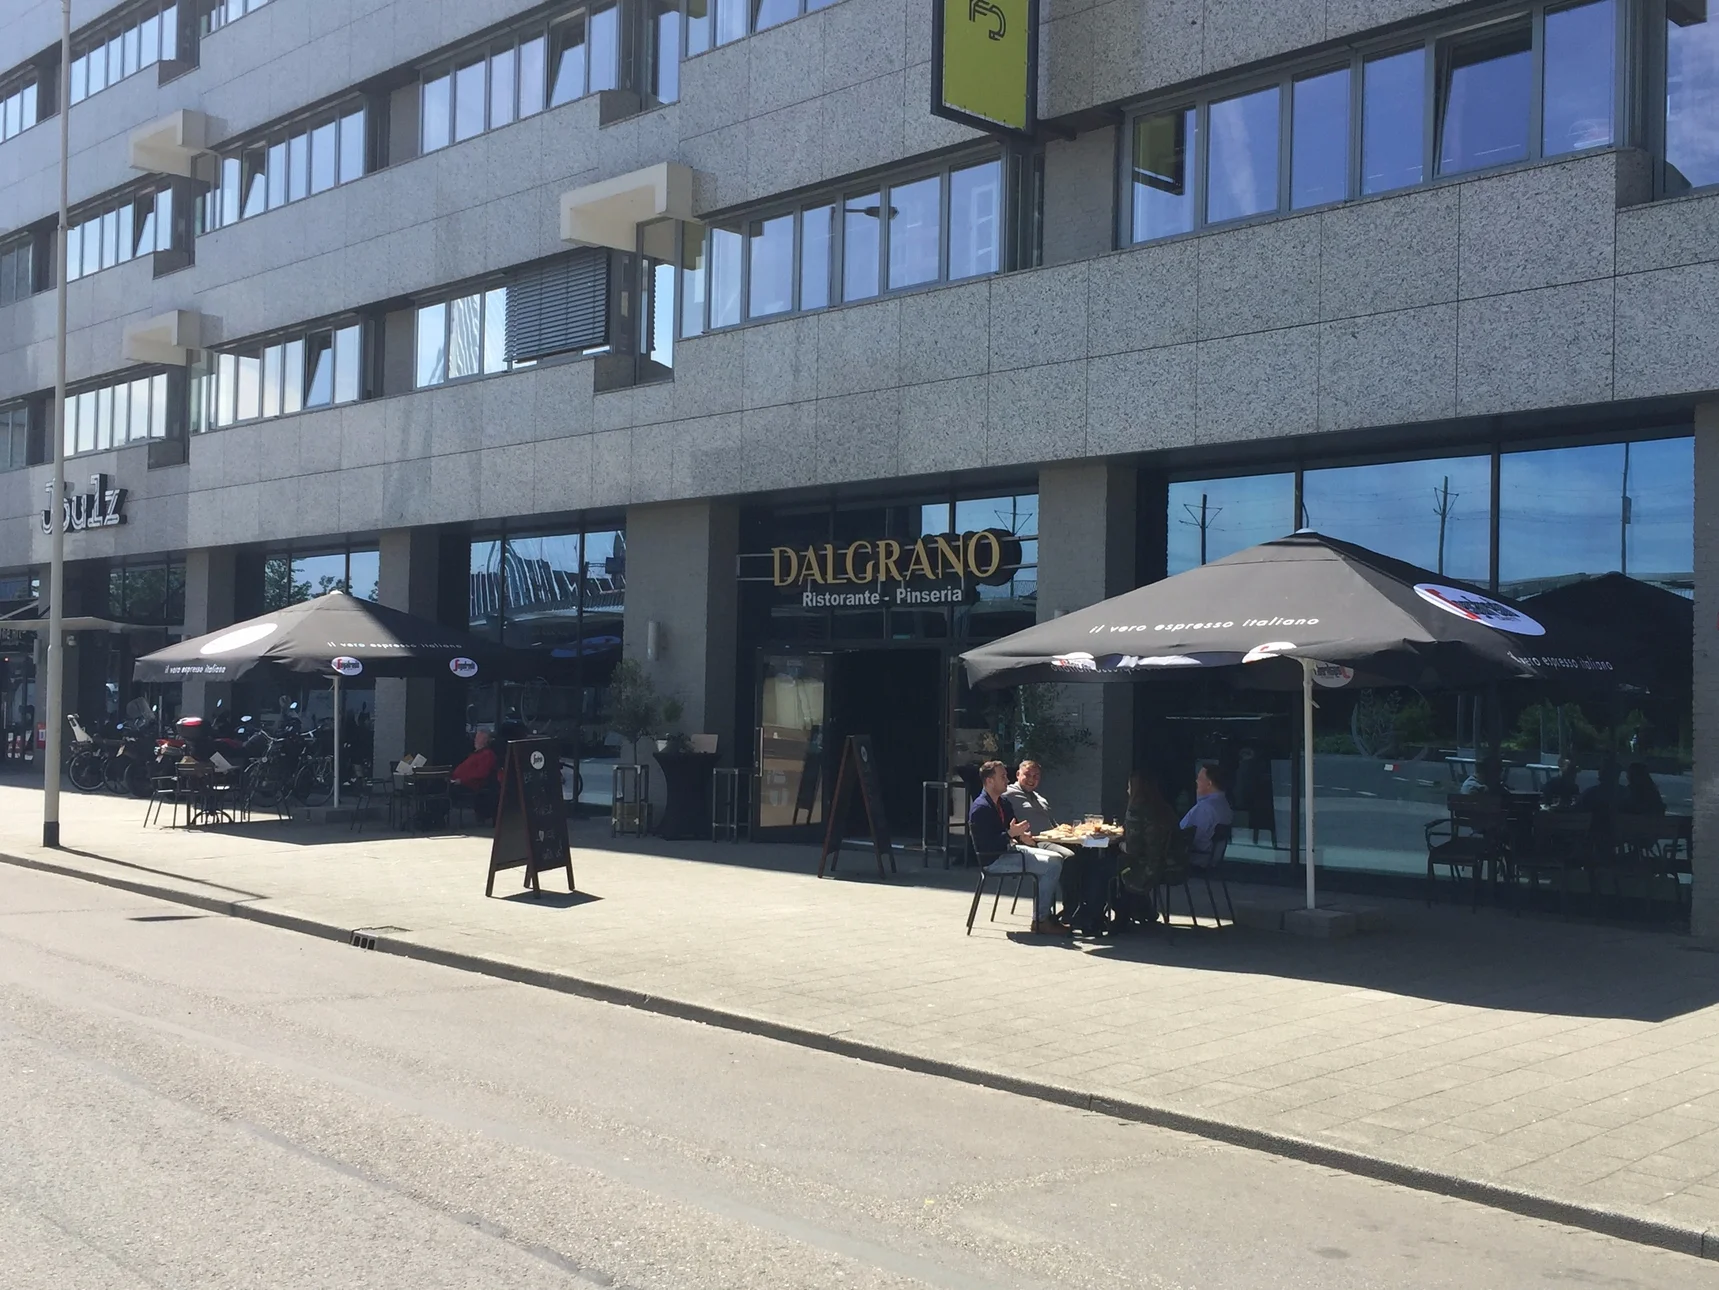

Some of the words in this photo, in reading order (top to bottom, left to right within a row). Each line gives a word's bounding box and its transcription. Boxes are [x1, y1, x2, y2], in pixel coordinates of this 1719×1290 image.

[771, 531, 1000, 587] DALGRANO
[802, 590, 880, 607] Ristorante
[896, 586, 962, 604] Pinseria
[1089, 624, 1105, 634] il
[1110, 624, 1147, 633] vero
[1153, 620, 1235, 633] espresso
[1241, 616, 1320, 627] italiano
[1541, 656, 1579, 671] espresso
[1577, 655, 1614, 671] italiano
